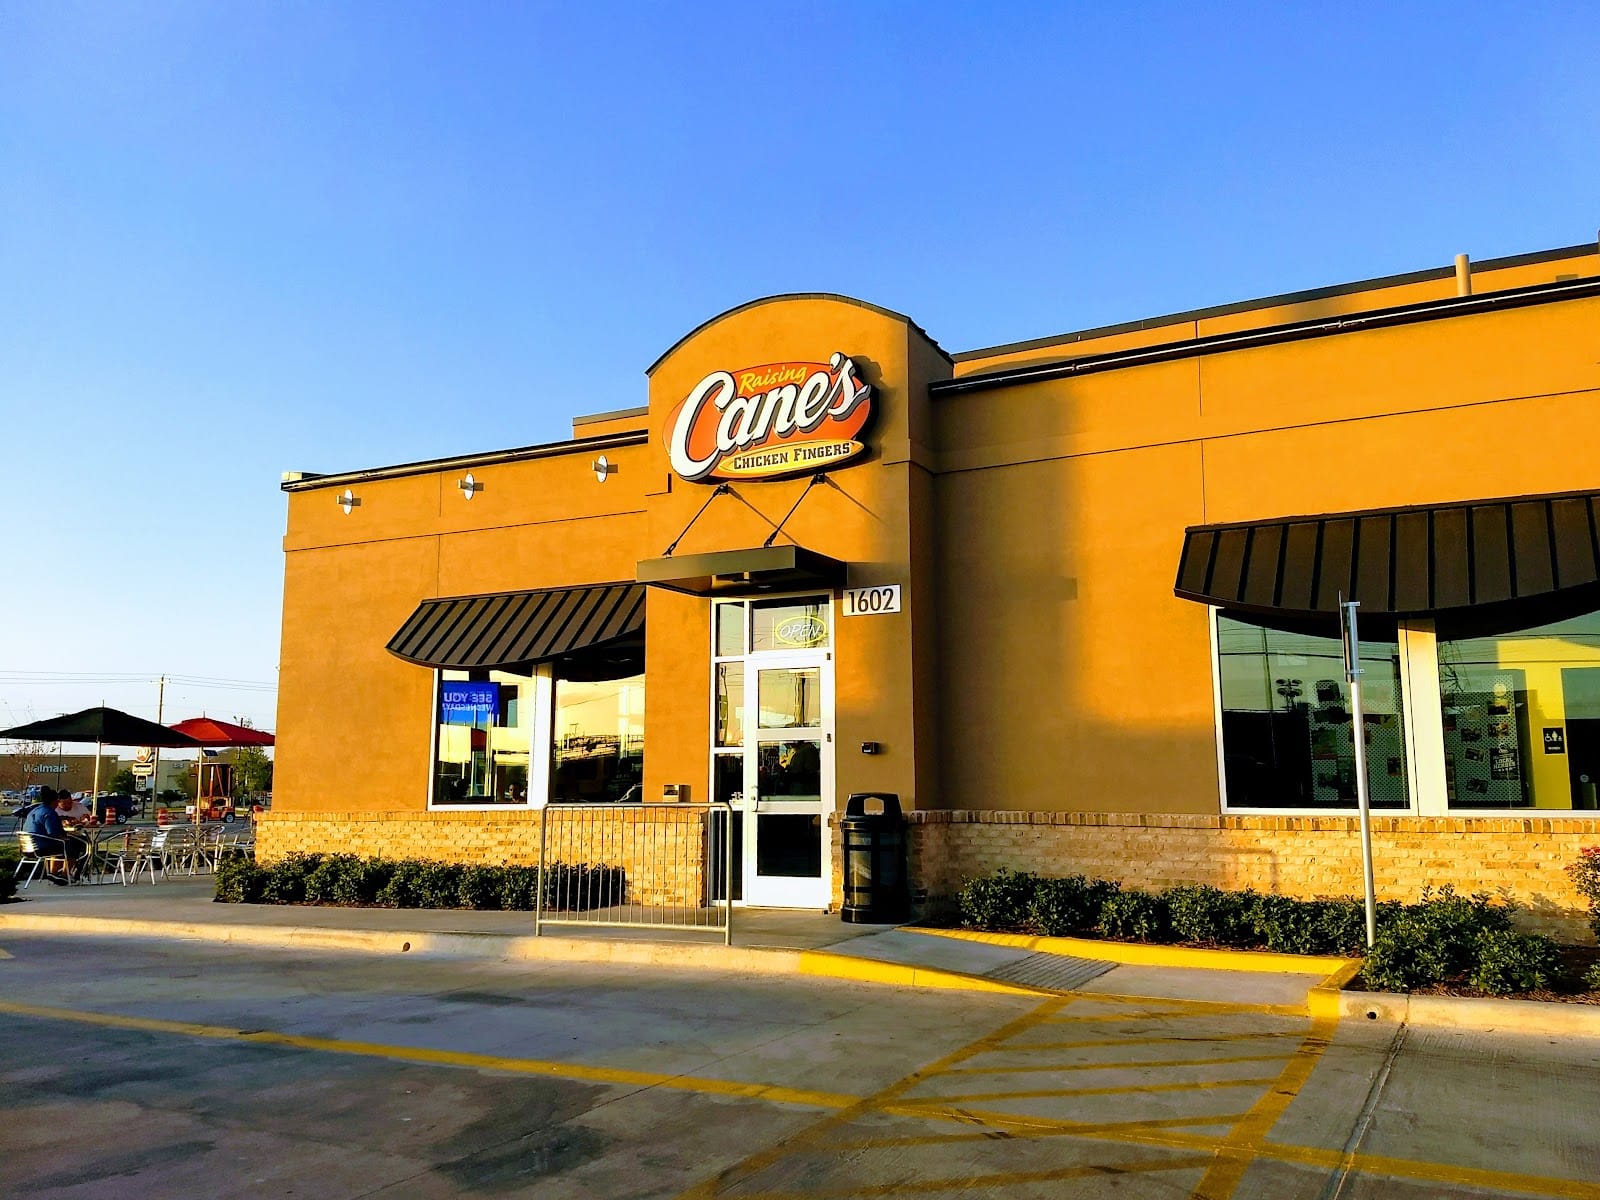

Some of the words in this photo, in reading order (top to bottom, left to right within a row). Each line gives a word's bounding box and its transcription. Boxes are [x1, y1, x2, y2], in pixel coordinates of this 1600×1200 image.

[738, 366, 807, 395] Raising
[670, 352, 872, 478] Cane's
[733, 452, 789, 470] CHICKEN
[793, 442, 850, 462] FINGERS
[848, 588, 894, 612] 1602
[780, 624, 821, 638] OPEN
[23, 763, 67, 773] Walmart
